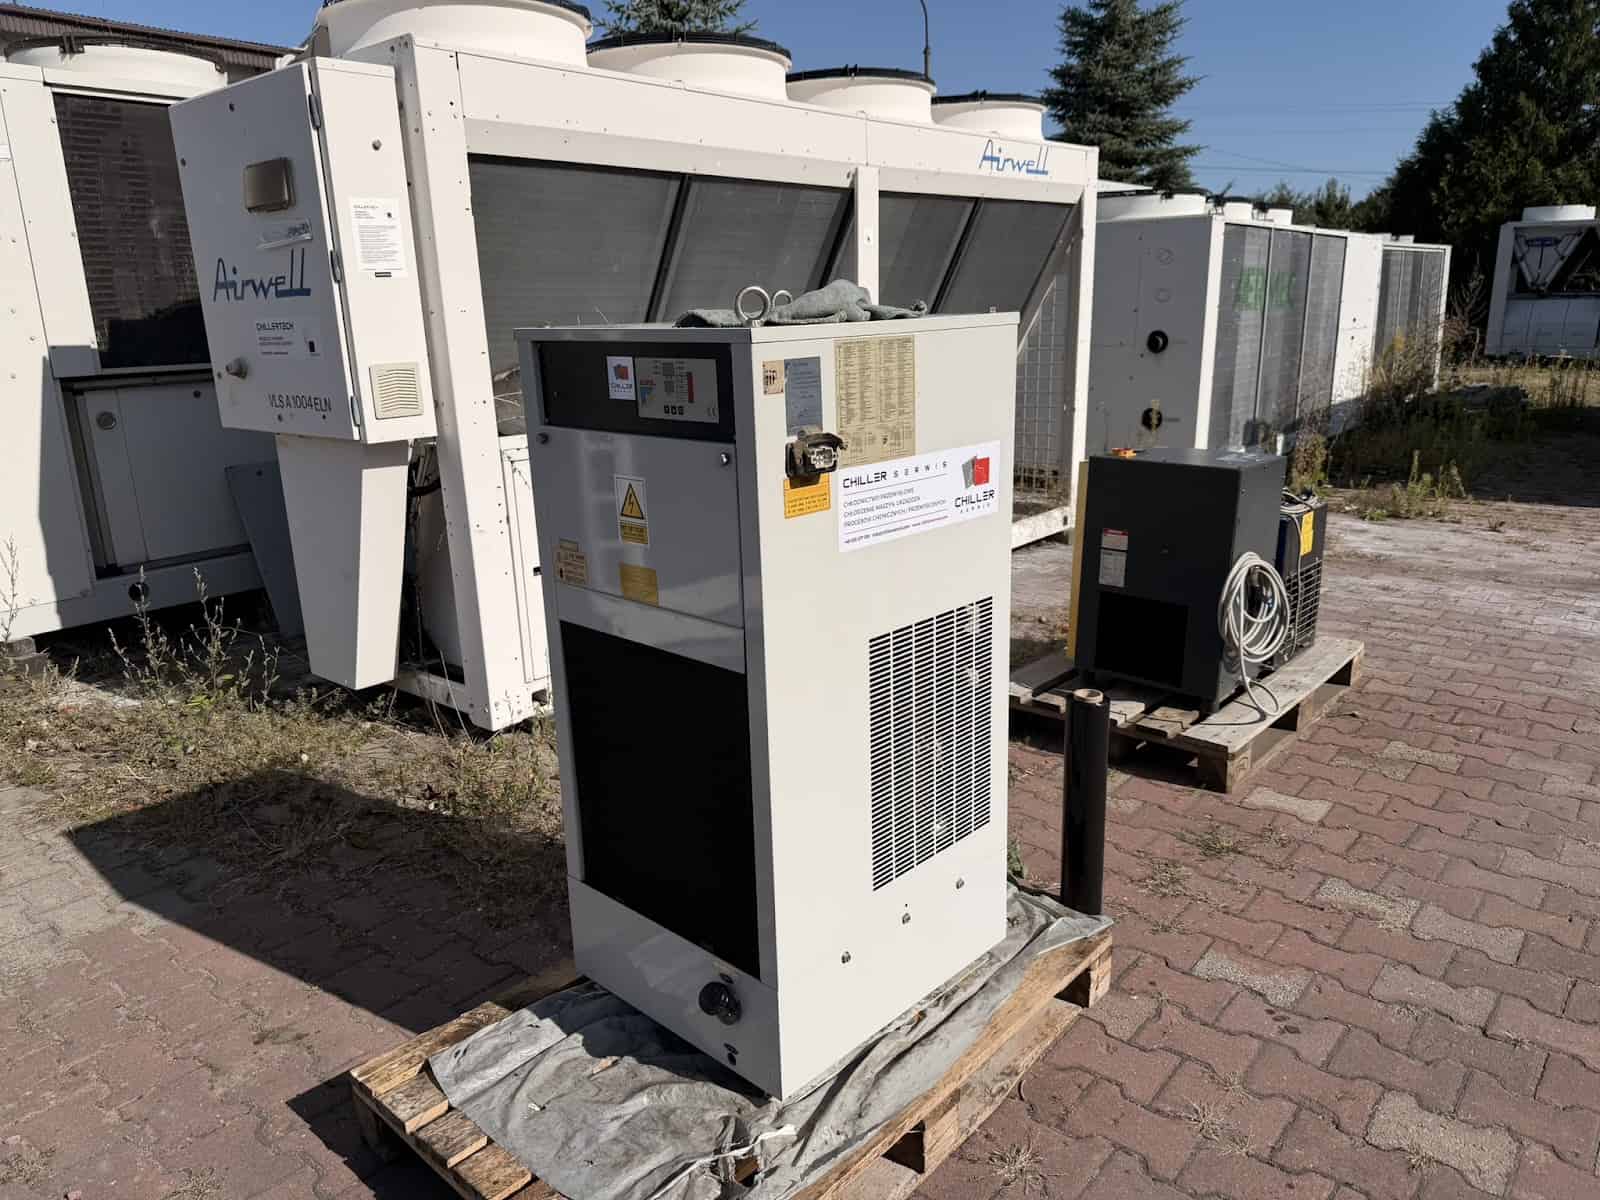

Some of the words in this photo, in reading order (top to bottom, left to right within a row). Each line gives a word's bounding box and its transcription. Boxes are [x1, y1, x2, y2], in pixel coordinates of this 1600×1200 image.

[979, 139, 1048, 175] Airwell
[213, 247, 311, 302] Airwell
[843, 471, 887, 488] CHILLER
[954, 489, 995, 508] CHILLER
